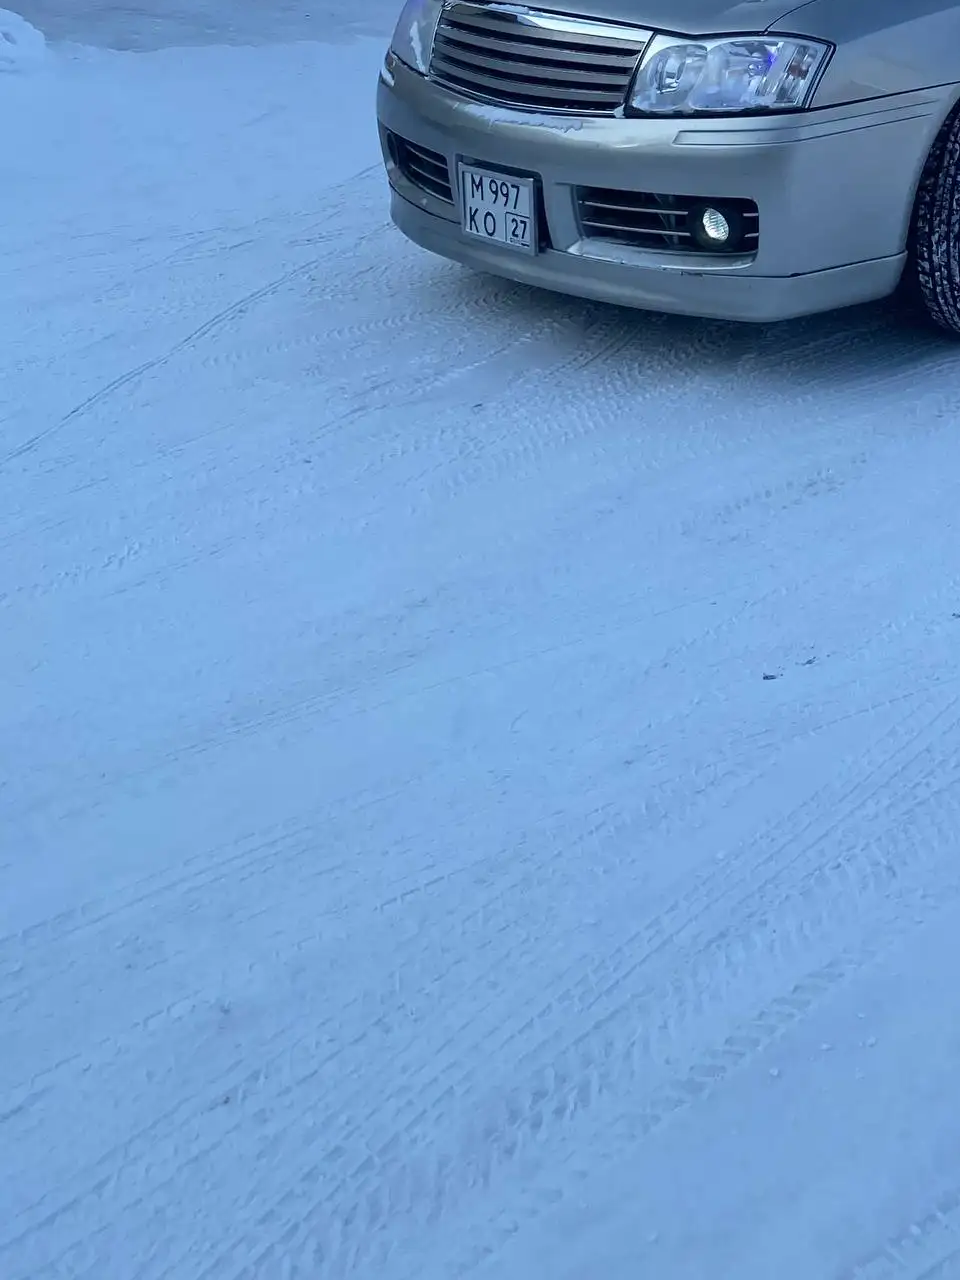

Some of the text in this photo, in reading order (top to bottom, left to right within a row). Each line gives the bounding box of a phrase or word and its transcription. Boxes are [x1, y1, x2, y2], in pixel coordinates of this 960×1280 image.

[470, 173, 520, 210] М 997
[468, 206, 527, 239] КО 27
